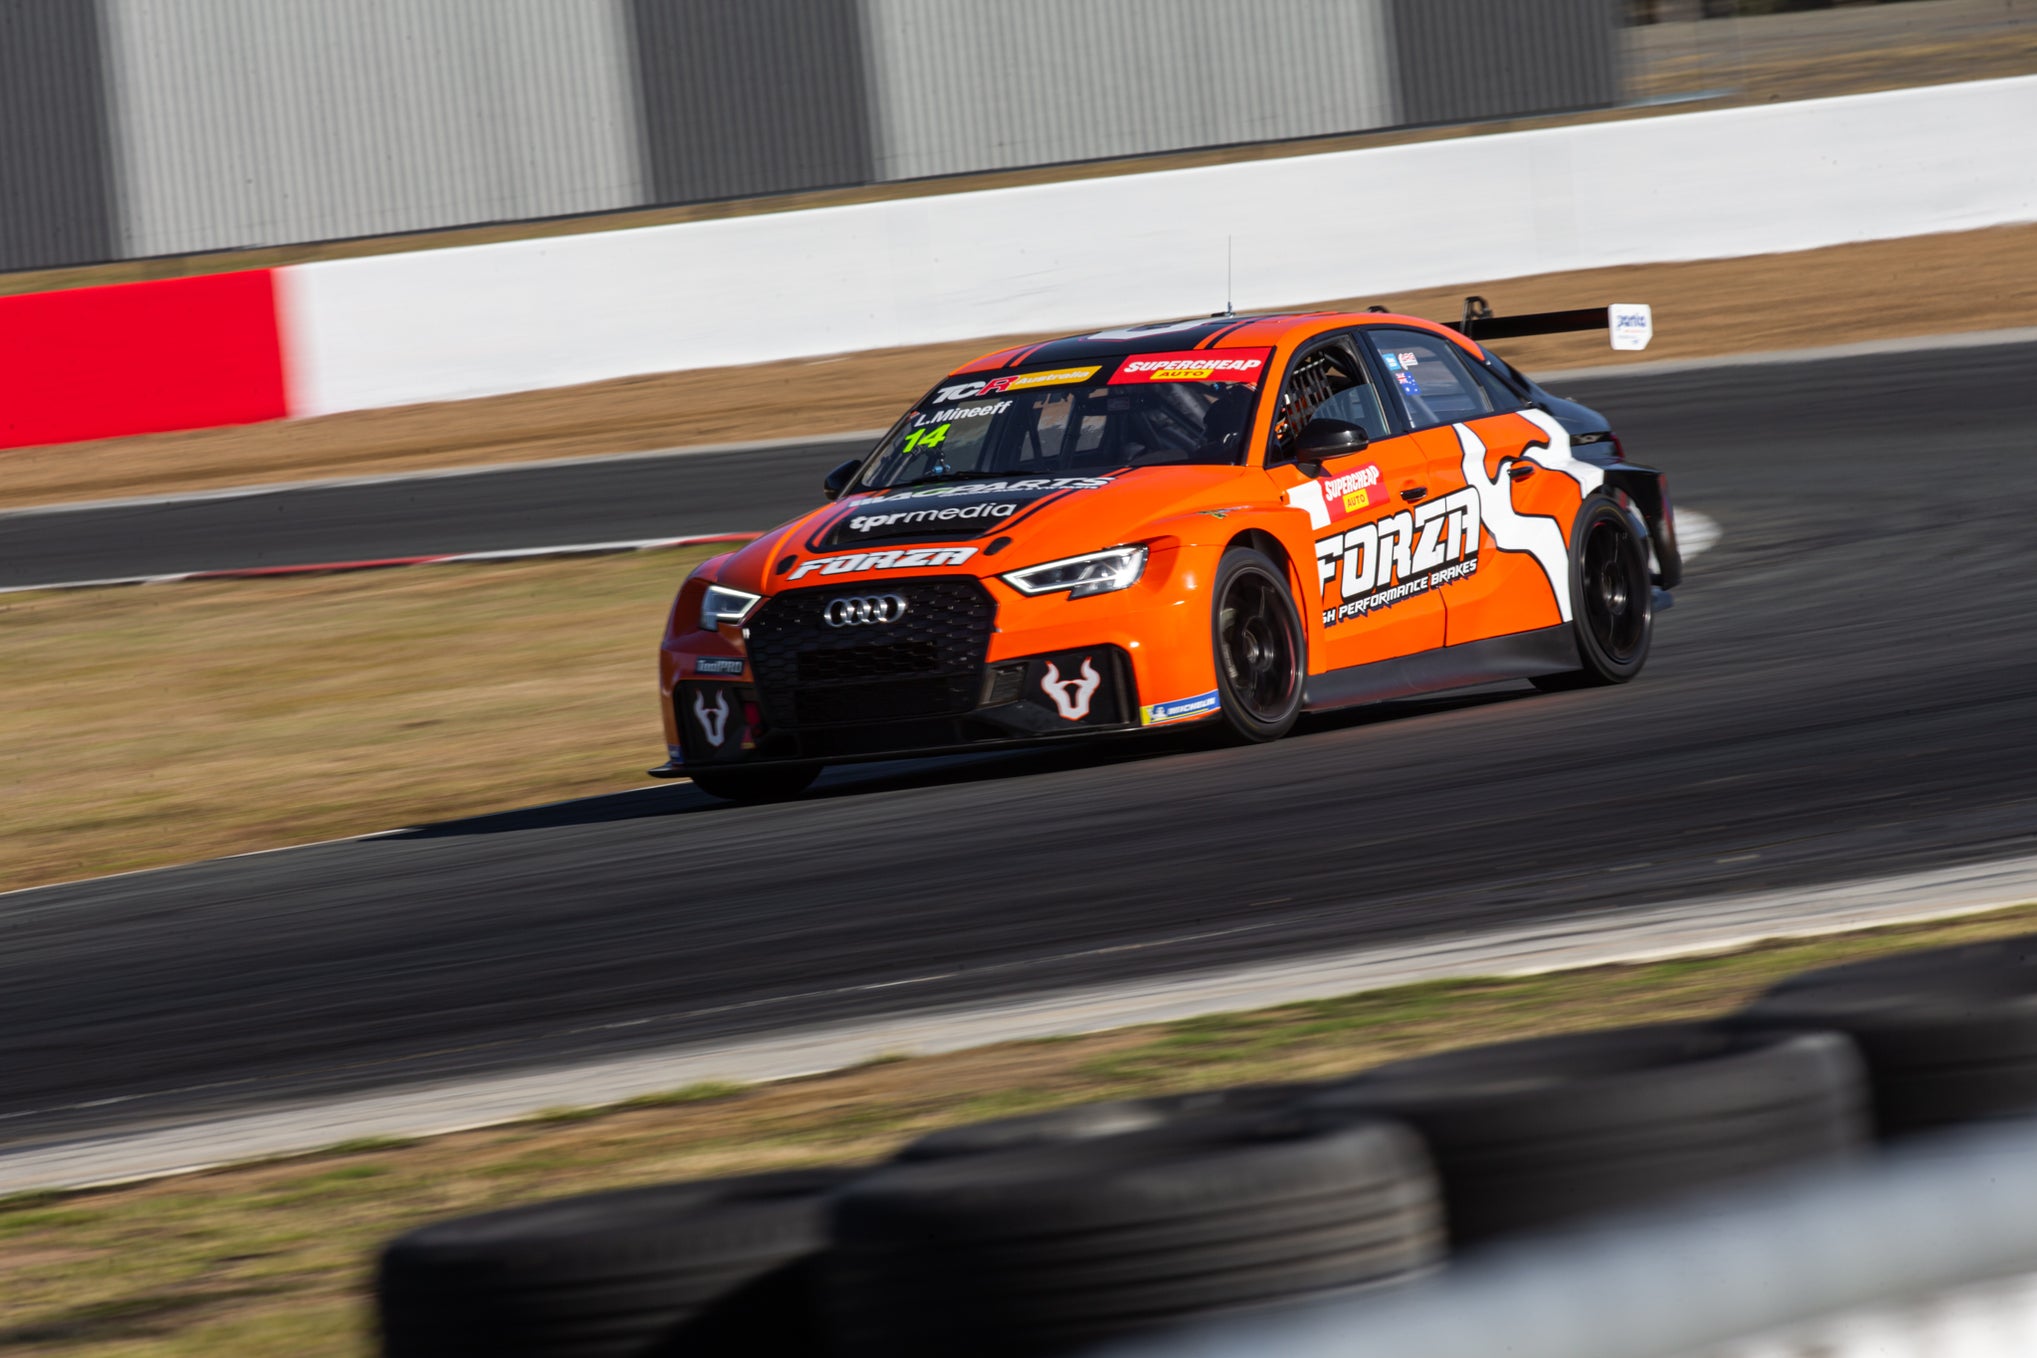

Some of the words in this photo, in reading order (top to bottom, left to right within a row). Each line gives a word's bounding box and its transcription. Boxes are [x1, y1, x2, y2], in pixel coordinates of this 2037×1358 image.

[1124, 359, 1262, 373] SUPERCHEAP
[932, 375, 1020, 404] TCR
[1016, 370, 1090, 385] Australia
[914, 400, 1013, 427] L.Mineeff
[903, 423, 952, 453] 14
[1324, 465, 1380, 501] SUPERCHEAP
[1347, 494, 1366, 508] AUTO
[850, 503, 1017, 533] tprmedia
[1314, 484, 1481, 598] FORZA
[787, 547, 979, 581] FORZA
[1338, 577, 1429, 619] PERFORMANCE
[1430, 558, 1478, 586] BRAKES
